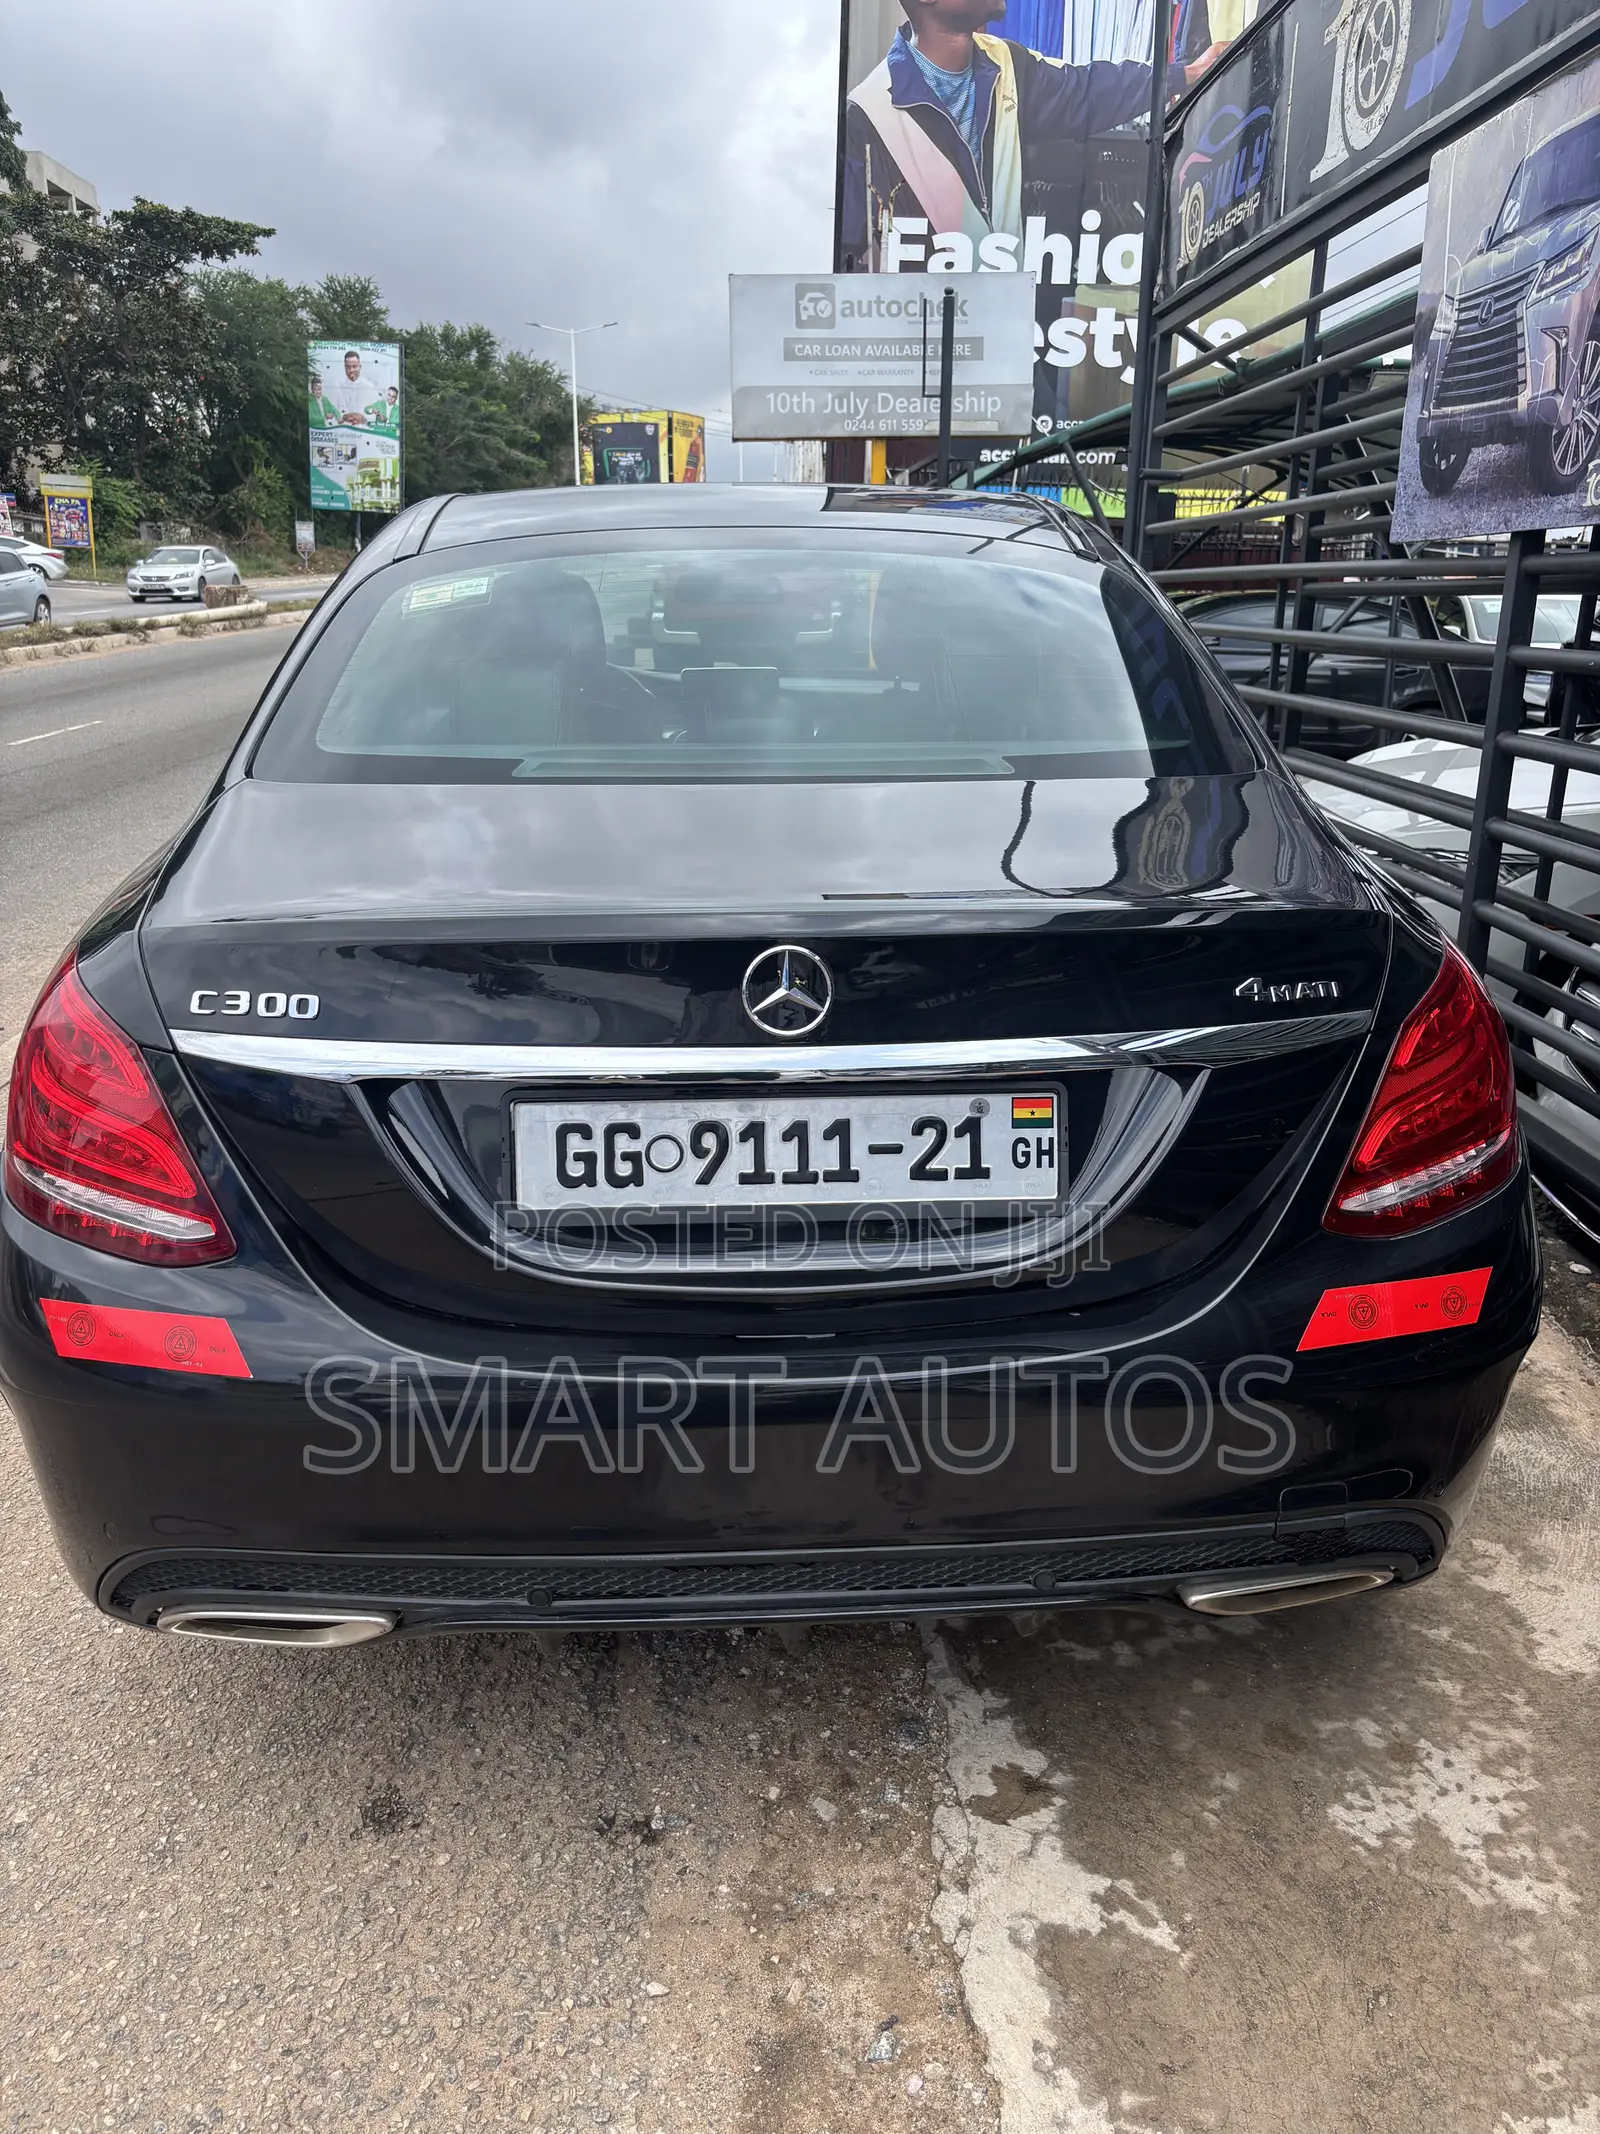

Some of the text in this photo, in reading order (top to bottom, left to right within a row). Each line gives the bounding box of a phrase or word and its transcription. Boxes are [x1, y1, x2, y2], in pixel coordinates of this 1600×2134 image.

[1206, 127, 1269, 223] JULY
[1202, 192, 1260, 249] DEALERSHIP
[885, 209, 1143, 286] Fashio
[795, 344, 822, 356] CAR
[825, 343, 861, 356] LOAN
[865, 343, 935, 356] AVAILABLE
[766, 391, 1001, 419] 10th July Dealeship
[844, 419, 875, 431] 0244
[879, 419, 897, 431] 611
[190, 990, 320, 1020] C300
[1233, 977, 1341, 1003] 4MATI
[555, 1115, 991, 1188] GG 9111-21
[1011, 1136, 1055, 1169] GH
